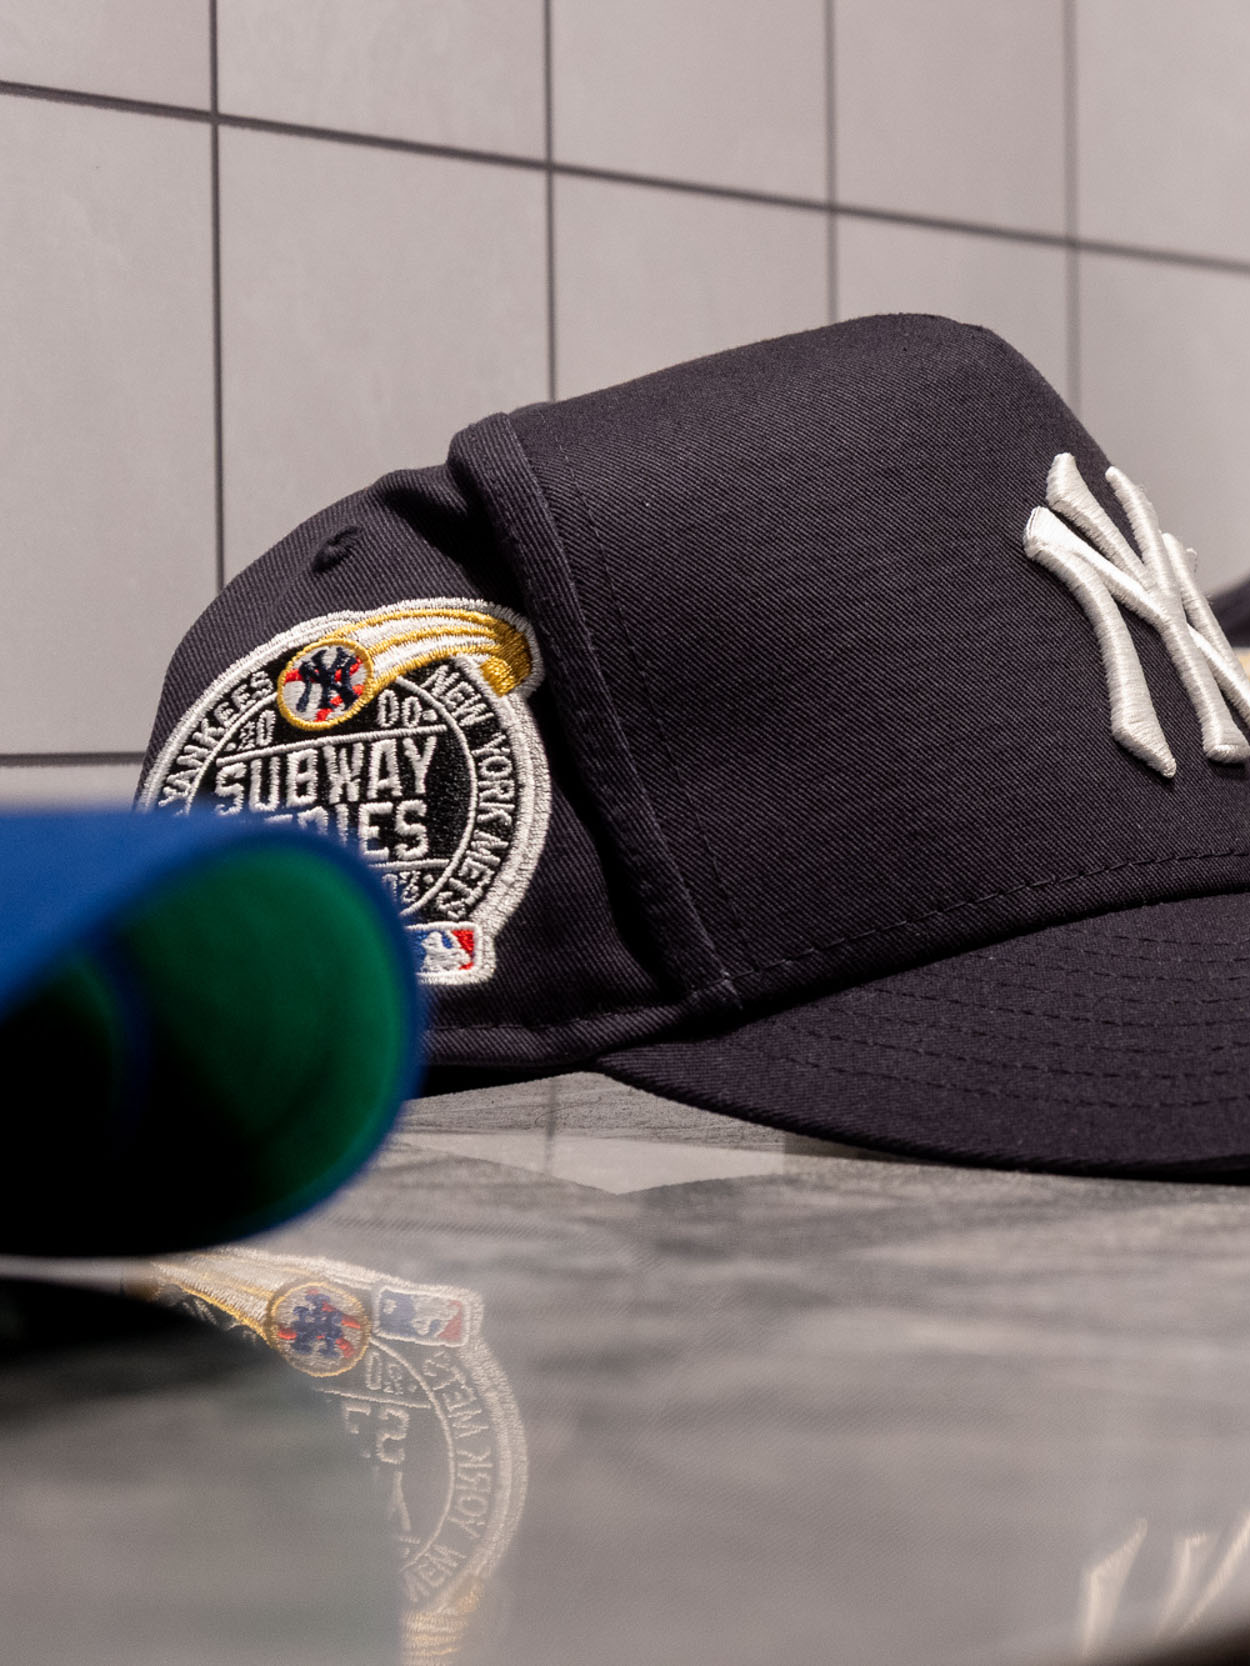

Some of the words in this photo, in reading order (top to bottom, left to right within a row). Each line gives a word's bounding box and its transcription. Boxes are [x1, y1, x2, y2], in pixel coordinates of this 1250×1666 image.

[420, 665, 494, 727] NEW
[214, 735, 437, 816] SUBWAY
[471, 732, 516, 826] YORK
[262, 799, 429, 862] IES
[436, 829, 509, 920] METS
